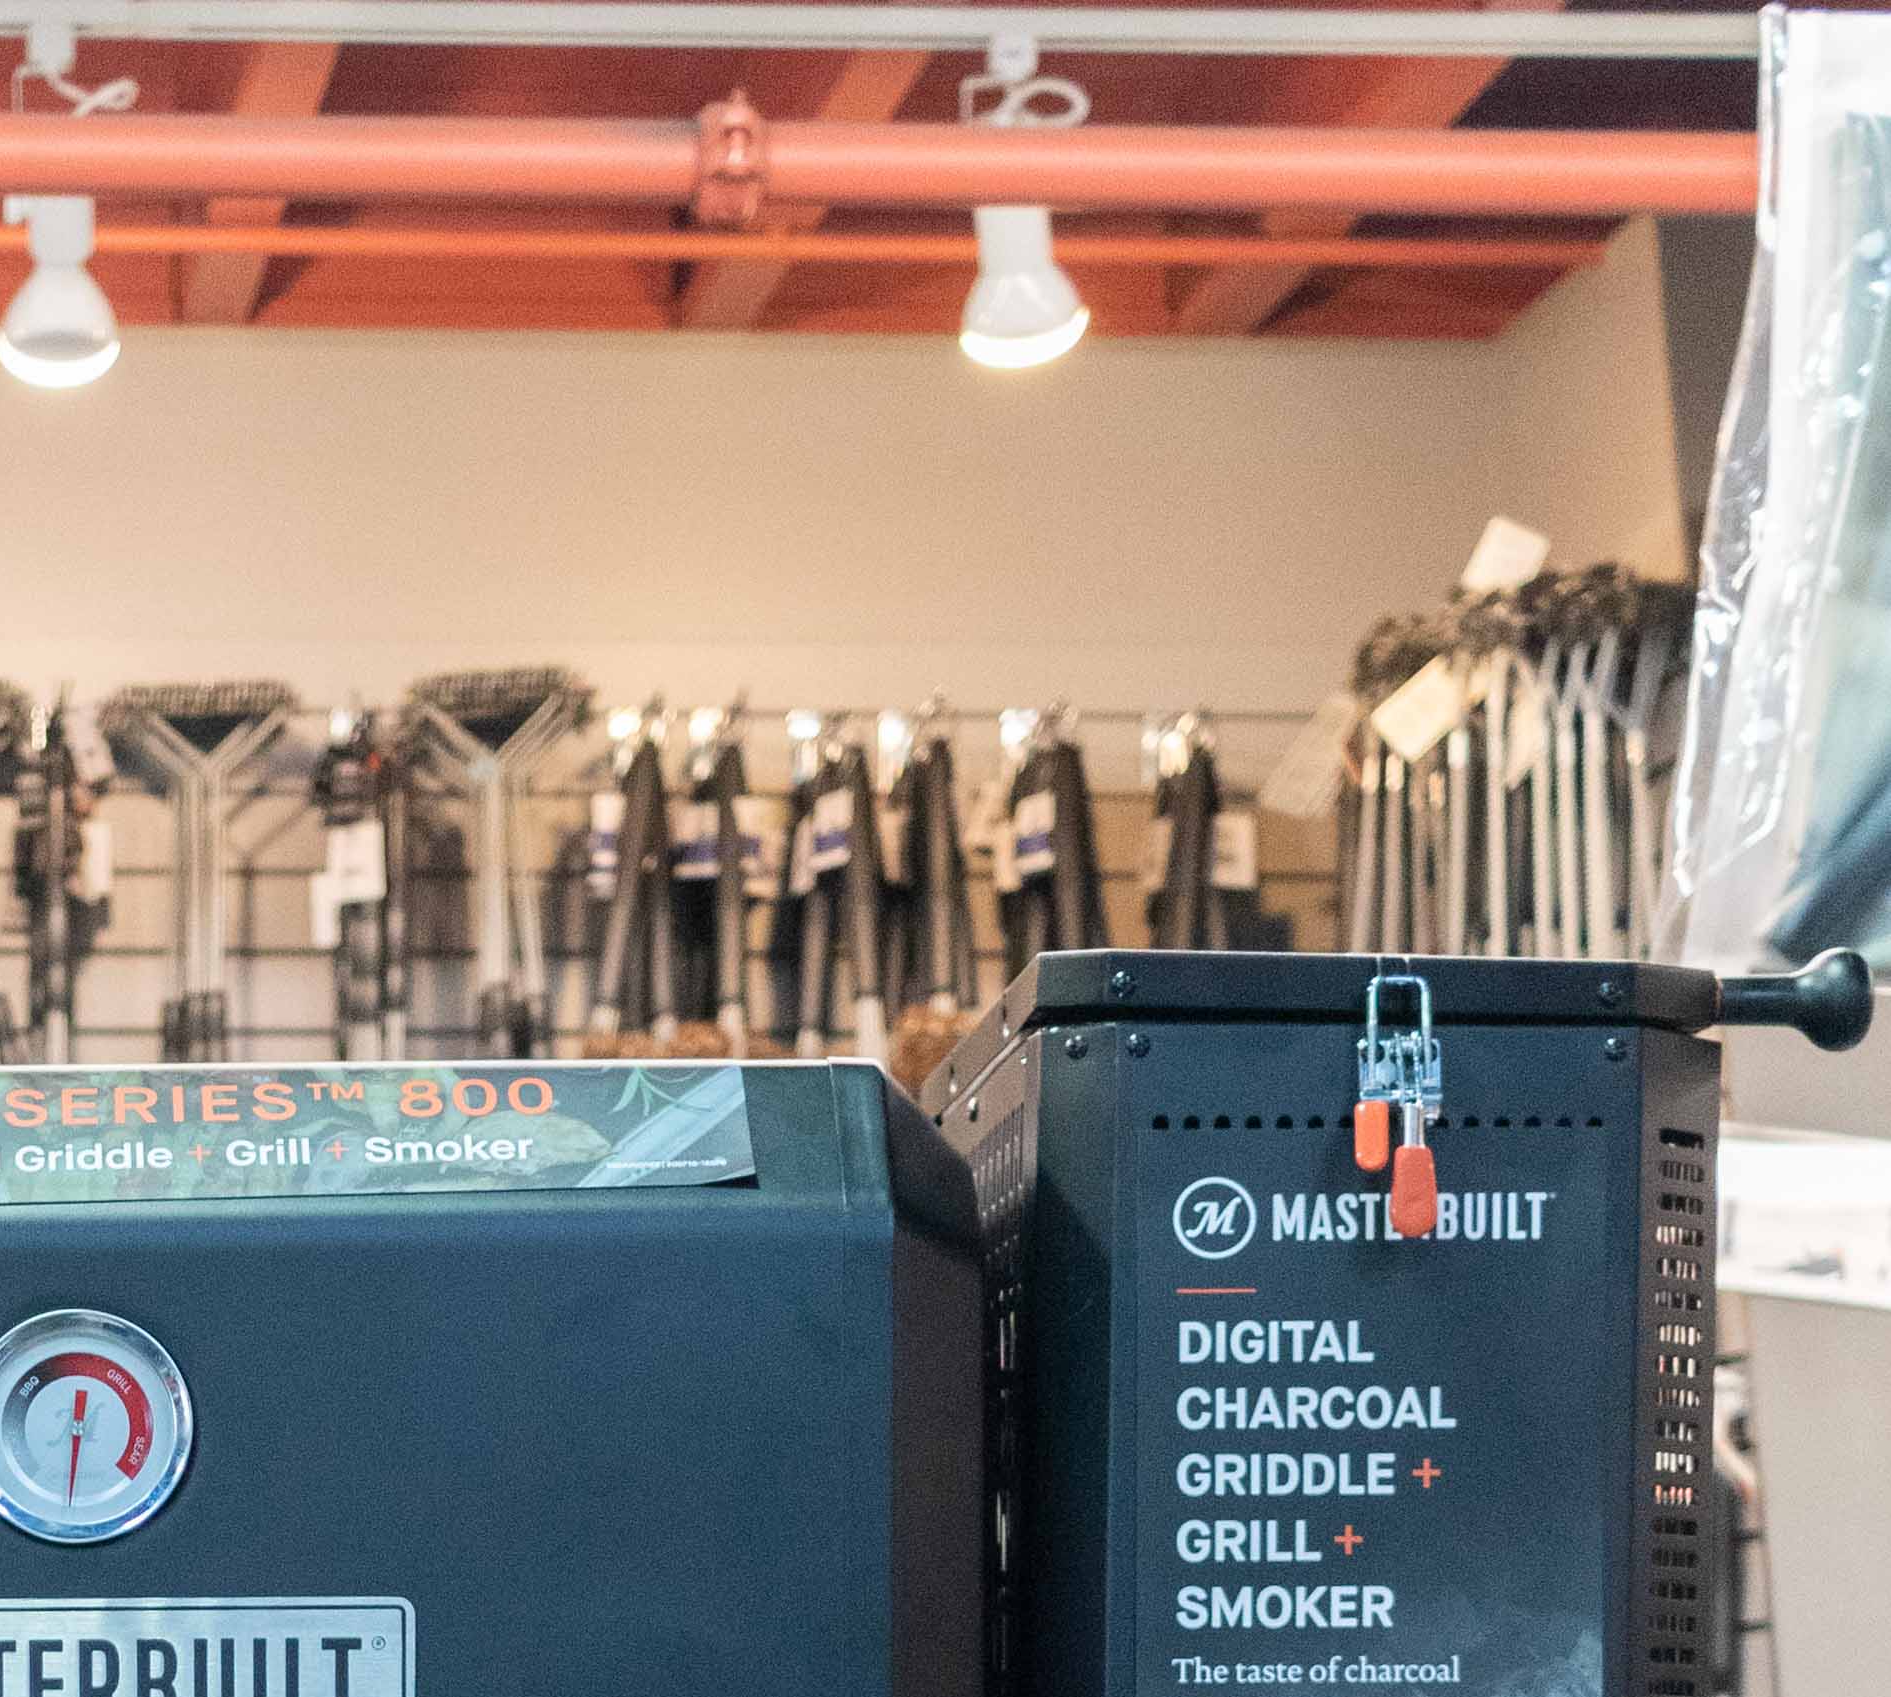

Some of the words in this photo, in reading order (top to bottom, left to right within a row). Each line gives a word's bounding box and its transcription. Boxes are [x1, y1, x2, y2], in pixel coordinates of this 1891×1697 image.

[399, 1077, 554, 1119] 800
[15, 1141, 174, 1172] Griddle
[226, 1137, 310, 1167] Grill
[364, 1133, 534, 1164] Smoker
[1272, 1192, 1548, 1241] MASTEBUILT
[1178, 1320, 1375, 1364] DIGITAL
[19, 1375, 40, 1397] BBQ
[107, 1369, 131, 1395] GRILL
[1177, 1386, 1457, 1430] CHARCOAL
[128, 1436, 145, 1465] SEAR
[1176, 1453, 1396, 1497] GRIDDLE
[1176, 1519, 1322, 1563] GRILL
[1176, 1585, 1395, 1629] SMOKER
[1171, 1656, 1229, 1683] The
[1235, 1661, 1304, 1683] taste
[1308, 1656, 1342, 1683] of
[1344, 1655, 1461, 1683] charcoal
